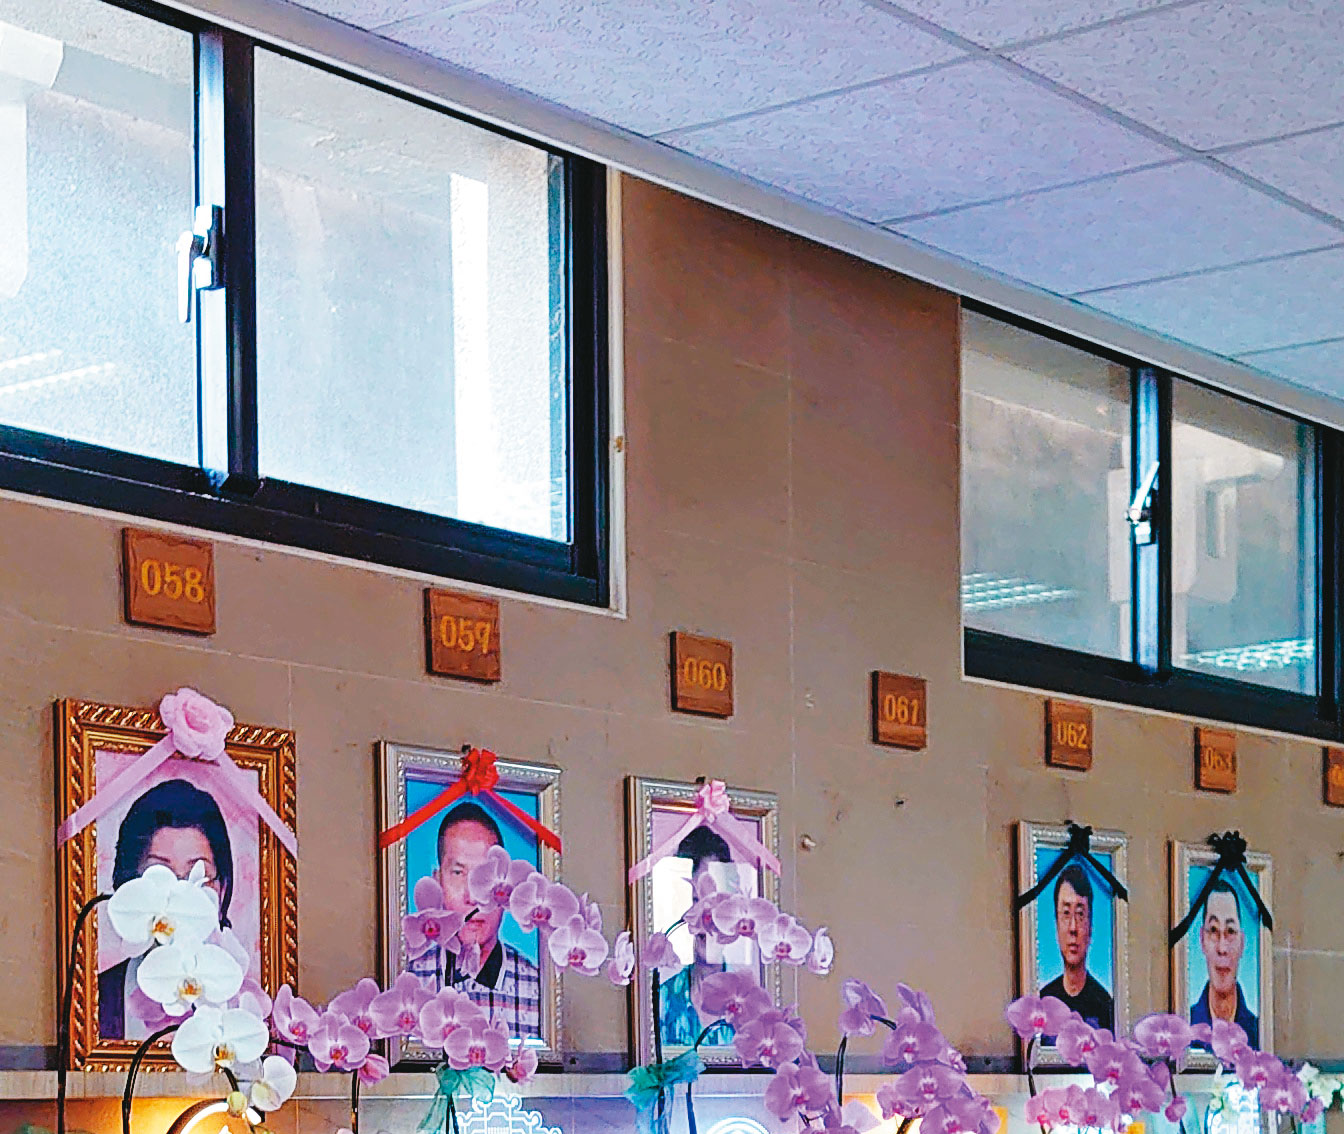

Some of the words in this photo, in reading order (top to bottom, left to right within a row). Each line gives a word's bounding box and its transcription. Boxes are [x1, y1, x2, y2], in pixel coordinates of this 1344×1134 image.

[141, 558, 205, 603] 058
[440, 615, 490, 654] 059
[683, 656, 727, 691] 060
[884, 693, 919, 725] 061
[1056, 721, 1088, 749] 062
